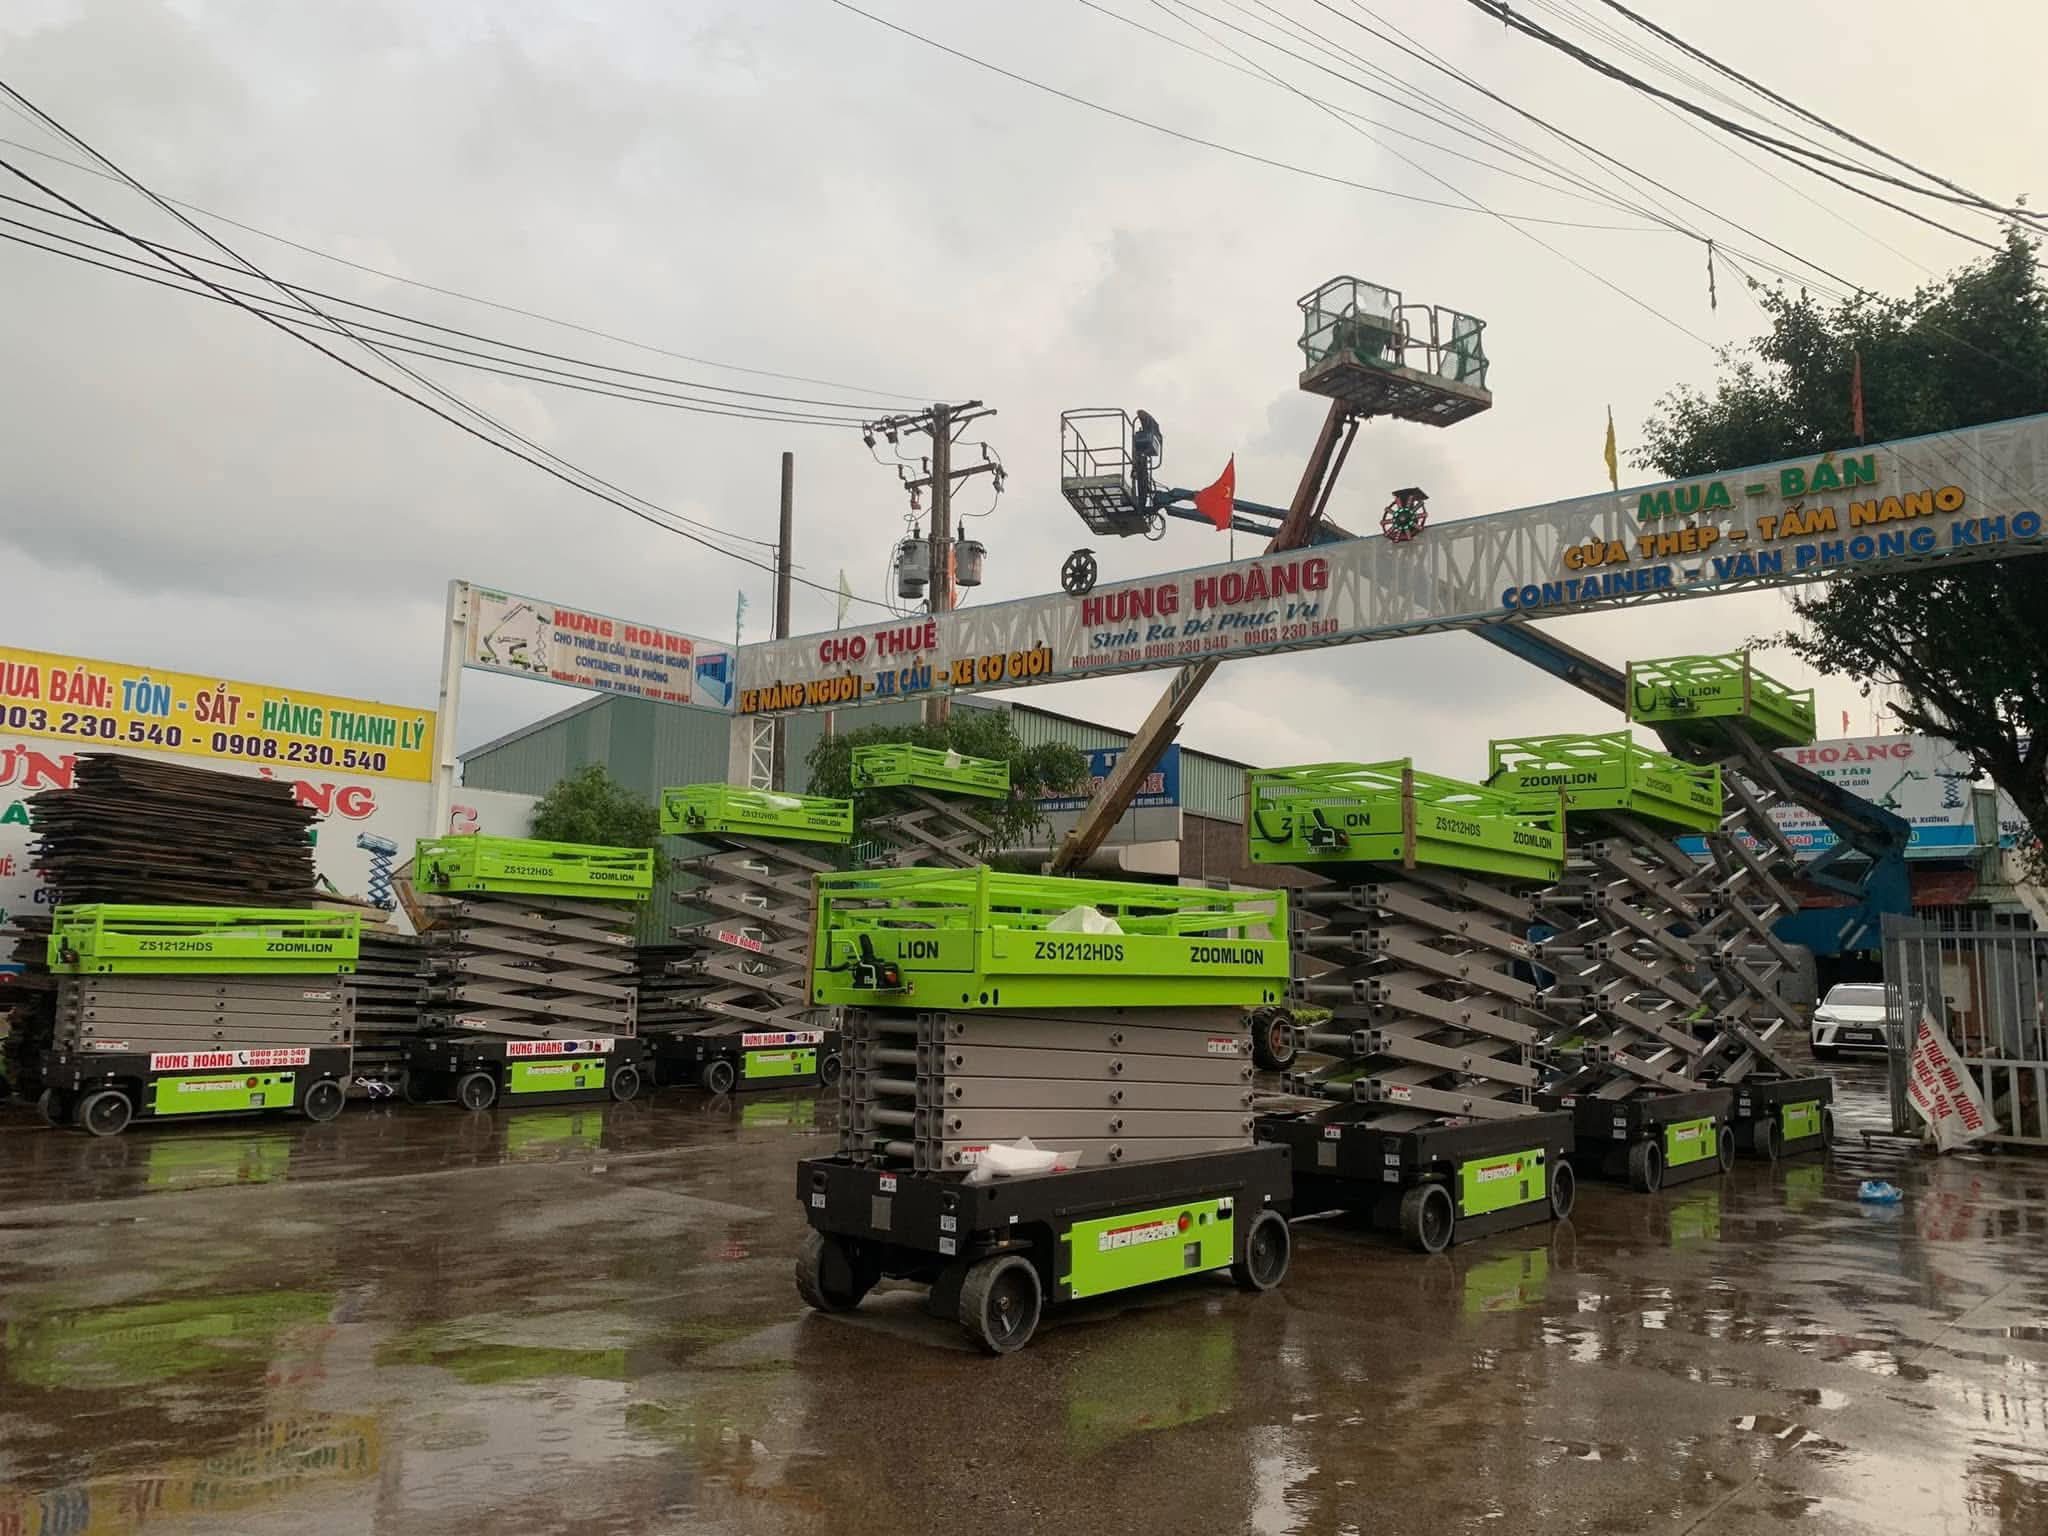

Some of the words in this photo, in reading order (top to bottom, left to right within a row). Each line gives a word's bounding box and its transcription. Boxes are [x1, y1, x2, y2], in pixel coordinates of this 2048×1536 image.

[1637, 481, 1732, 522] MUA
[1780, 451, 1877, 497] BÁN
[1564, 536, 1628, 570] CỬA
[1638, 521, 1719, 559] THÉP
[1758, 500, 1837, 541] TẤM
[1849, 485, 1966, 527] NANO
[1502, 566, 1674, 609] CONTAINER
[1952, 511, 2042, 547] KHO
[1082, 583, 1179, 627] HƯNG
[1194, 558, 1329, 610] HOÀNG
[554, 609, 614, 638] HƯNG
[625, 626, 693, 655] HOÀNG
[554, 632, 573, 645] CHO
[819, 635, 866, 664] CHO
[875, 616, 937, 657] THUÊ
[1091, 627, 1138, 649] Sinh
[1146, 623, 1176, 641] Ra
[1286, 601, 1320, 620] Vụ
[1178, 639, 1200, 655] 230
[1244, 627, 1278, 646] 0903
[1281, 622, 1308, 641] 230
[1311, 617, 1340, 634] 540
[575, 656, 621, 674] CONTAINER
[739, 689, 759, 714] XE
[806, 670, 862, 707] NGƯỜI
[875, 670, 899, 695] XE
[951, 659, 974, 686] XE
[977, 653, 1004, 681] CƠ
[1007, 640, 1054, 678] GIỚI
[49, 666, 113, 709] BÁN:
[122, 675, 171, 716] TÔN
[195, 682, 241, 726] SẮT
[263, 698, 322, 739] HÀNG
[330, 709, 397, 747] THANH
[401, 717, 426, 751] LÝ
[212, 732, 387, 772] 0908.230.540
[1797, 740, 1914, 765] HOÀNG
[1520, 772, 1597, 788] ZOOMLION
[1436, 816, 1481, 837] ZS1212HDS
[1513, 831, 1552, 850] ZOOMLION
[504, 865, 553, 877] ZS1212HDS
[589, 871, 634, 882] ZOOMLION
[139, 941, 213, 952] ZS1212HDS
[266, 943, 333, 953] ZOOMLION
[1035, 941, 1125, 962] ZS1212HDS
[1190, 946, 1264, 965] ZOOMLION
[273, 1049, 289, 1057] 230
[273, 1057, 288, 1065] 230
